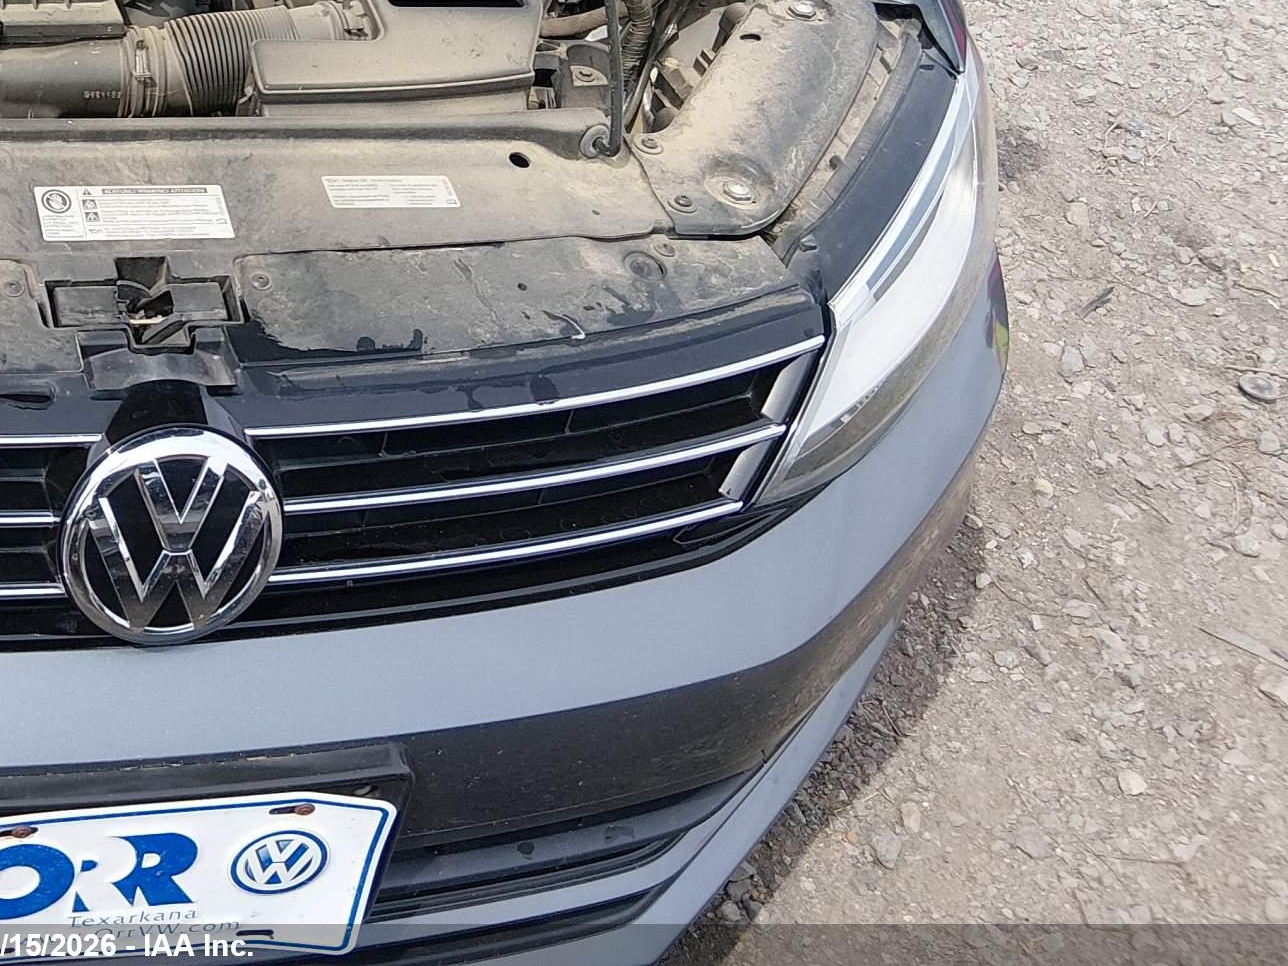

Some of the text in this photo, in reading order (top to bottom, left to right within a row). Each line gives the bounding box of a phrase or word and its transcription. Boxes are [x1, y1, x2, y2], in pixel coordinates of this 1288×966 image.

[85, 451, 272, 634] VW
[242, 836, 318, 887] VW
[67, 907, 197, 928] Texarkana
